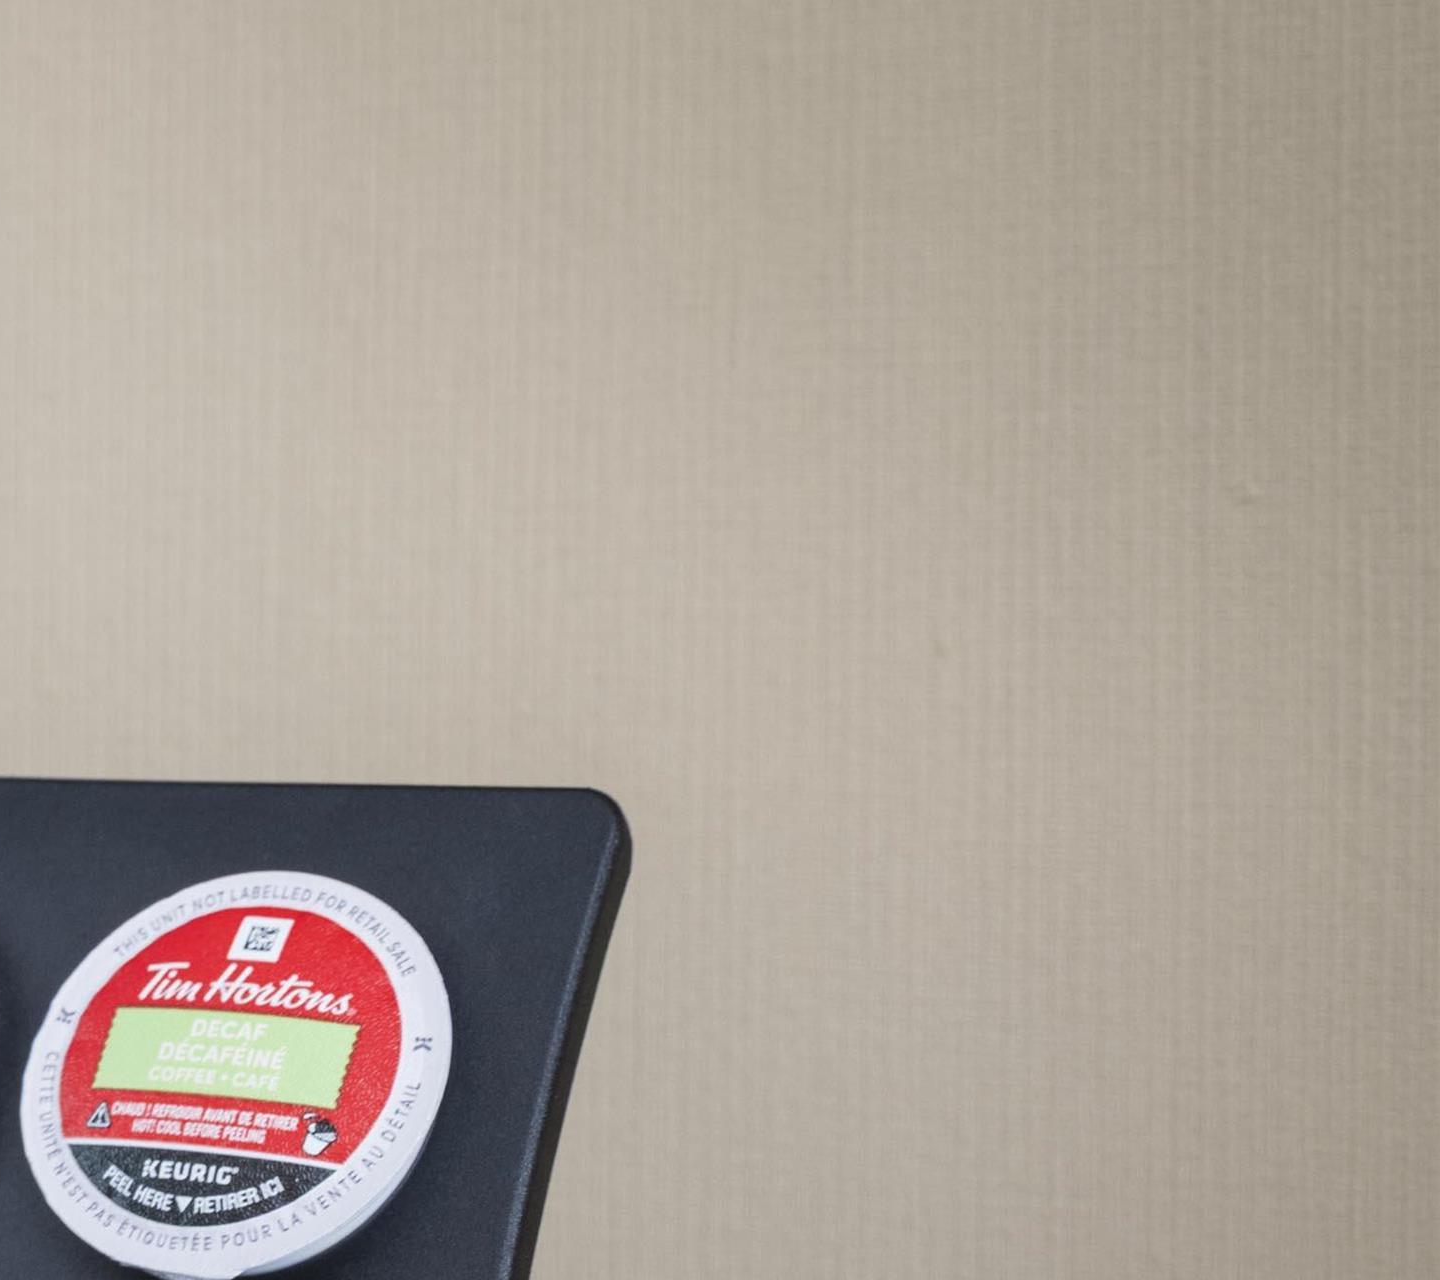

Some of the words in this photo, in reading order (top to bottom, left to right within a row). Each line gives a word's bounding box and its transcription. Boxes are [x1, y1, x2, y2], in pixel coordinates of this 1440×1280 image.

[113, 926, 148, 958] THIS
[150, 904, 186, 932] UNIT
[191, 890, 226, 911] NOT
[230, 883, 312, 903] LABELLED
[315, 891, 349, 915] FOR
[347, 905, 391, 945] RETAIL
[385, 941, 418, 978] SALE
[138, 961, 204, 1002] Tim
[203, 962, 355, 1017] Hortons
[157, 1038, 289, 1071] DÉCAFÉINÉ
[190, 1018, 269, 1042] DECAF
[147, 1066, 218, 1086] COFFEE
[39, 1051, 60, 1105] CETTE
[84, 1200, 117, 1229] PAS
[116, 1223, 213, 1252] ÉTIQUETÉE
[220, 1223, 273, 1251] POUR
[277, 1212, 304, 1233] LA
[303, 1169, 364, 1217] VENTE
[361, 1145, 385, 1169] AU
[381, 1080, 422, 1144] DÉTAIL
[102, 1163, 134, 1199] PEEL
[133, 1183, 175, 1212] HERE
[193, 1185, 261, 1215] RETIRER
[259, 1175, 285, 1201] ICI
